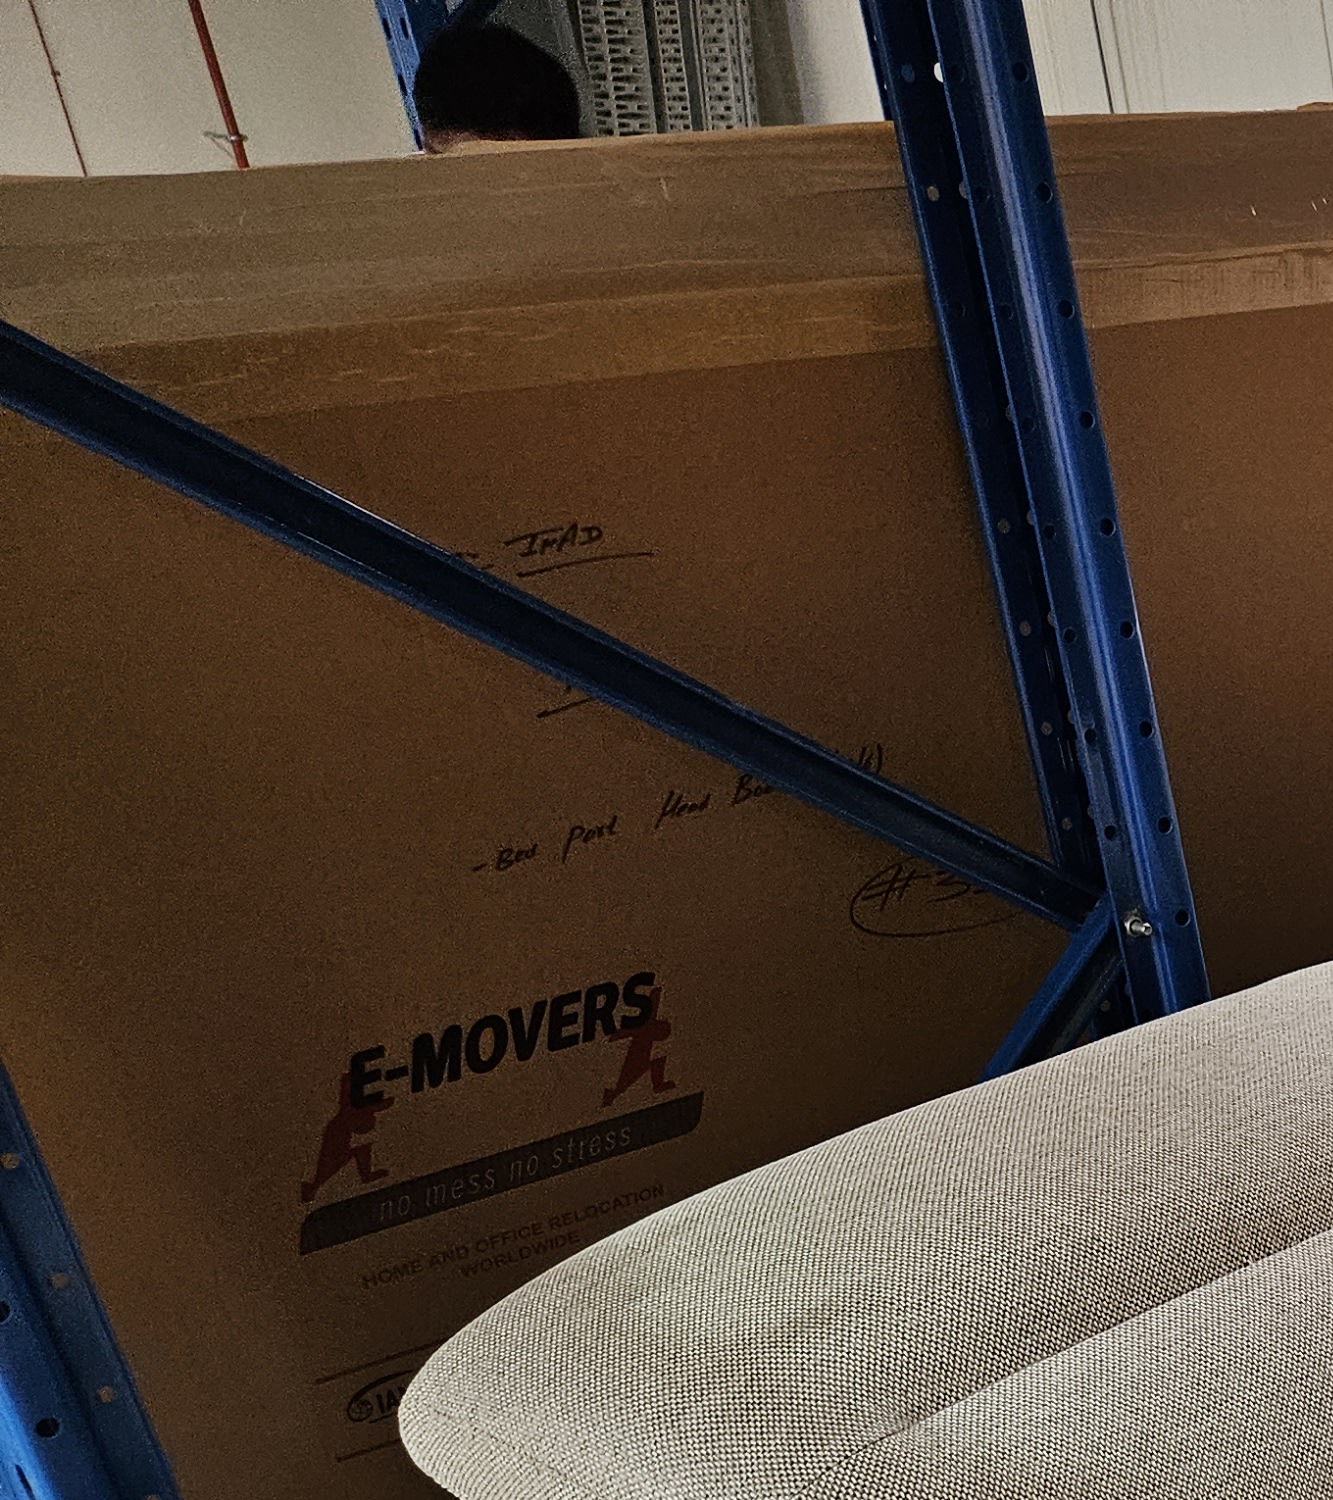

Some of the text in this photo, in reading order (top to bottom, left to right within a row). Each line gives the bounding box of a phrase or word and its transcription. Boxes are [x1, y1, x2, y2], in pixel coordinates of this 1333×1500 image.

[350, 971, 656, 1109] E-MOVERS
[379, 1126, 632, 1222] no mess no stress
[361, 1183, 666, 1290] HOME AND OFFICE RELOCATION
[460, 1231, 582, 1278] WORLDWIDE
